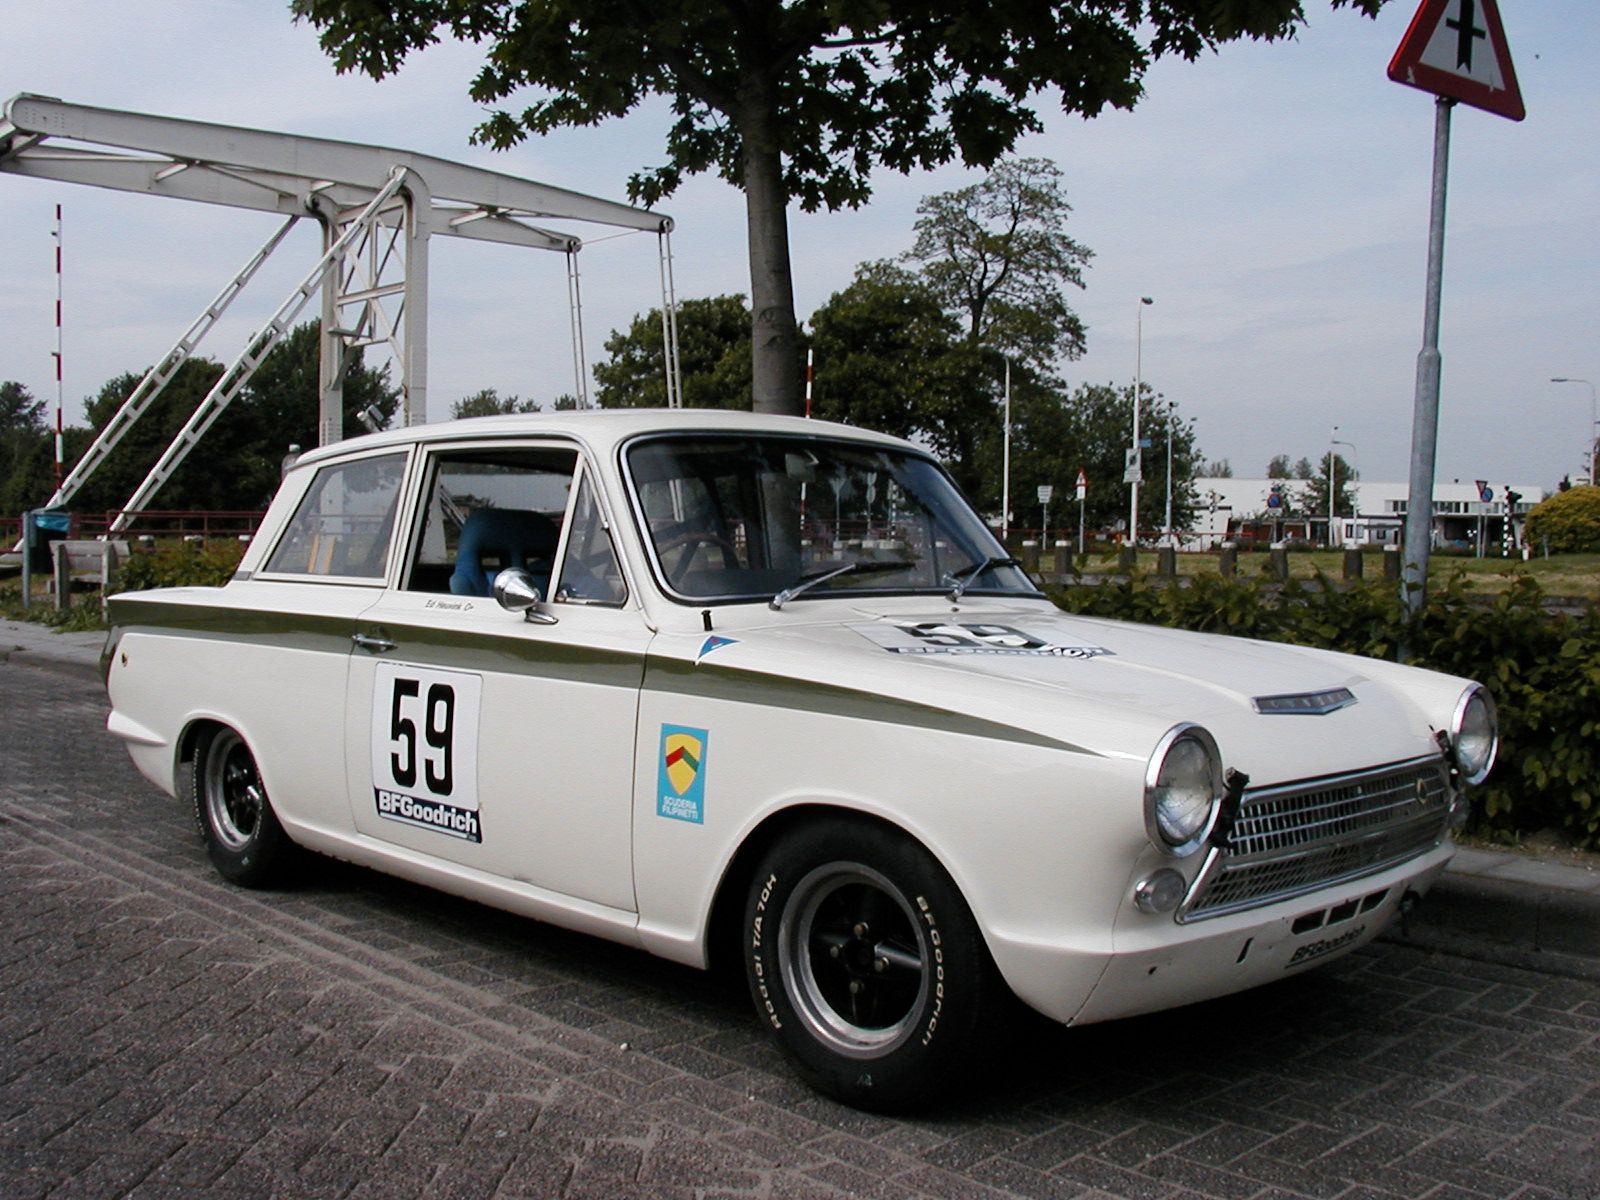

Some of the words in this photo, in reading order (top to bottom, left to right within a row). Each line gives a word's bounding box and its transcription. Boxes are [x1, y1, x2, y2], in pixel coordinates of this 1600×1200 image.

[894, 622, 1049, 649] 59
[391, 677, 455, 796] 59
[379, 790, 477, 834] BFGoodrich
[753, 916, 763, 949] T/A
